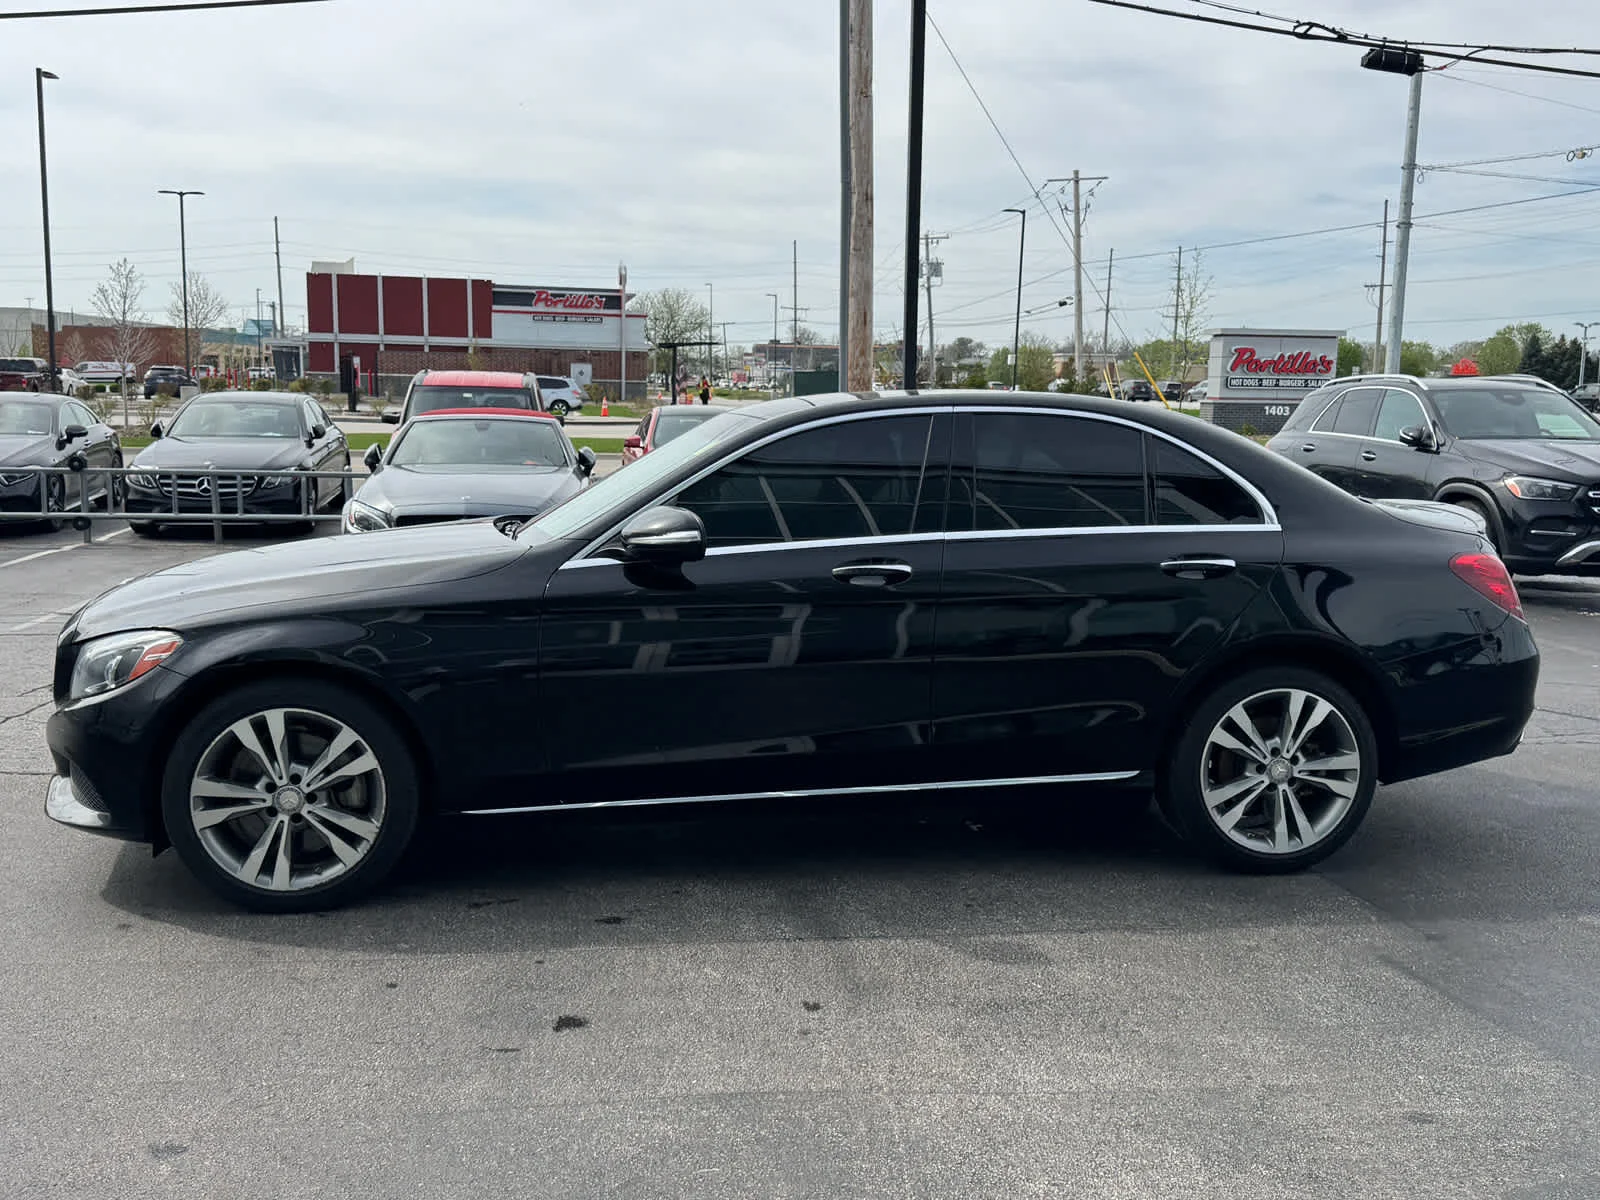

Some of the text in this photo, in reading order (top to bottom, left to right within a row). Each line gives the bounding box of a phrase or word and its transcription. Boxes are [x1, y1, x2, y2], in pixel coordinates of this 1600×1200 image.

[533, 290, 606, 310] Portillo's
[1229, 346, 1334, 375] Portillo's
[1231, 378, 1242, 386] HOT
[1243, 378, 1258, 386] DOGS
[1264, 405, 1290, 416] 1403
